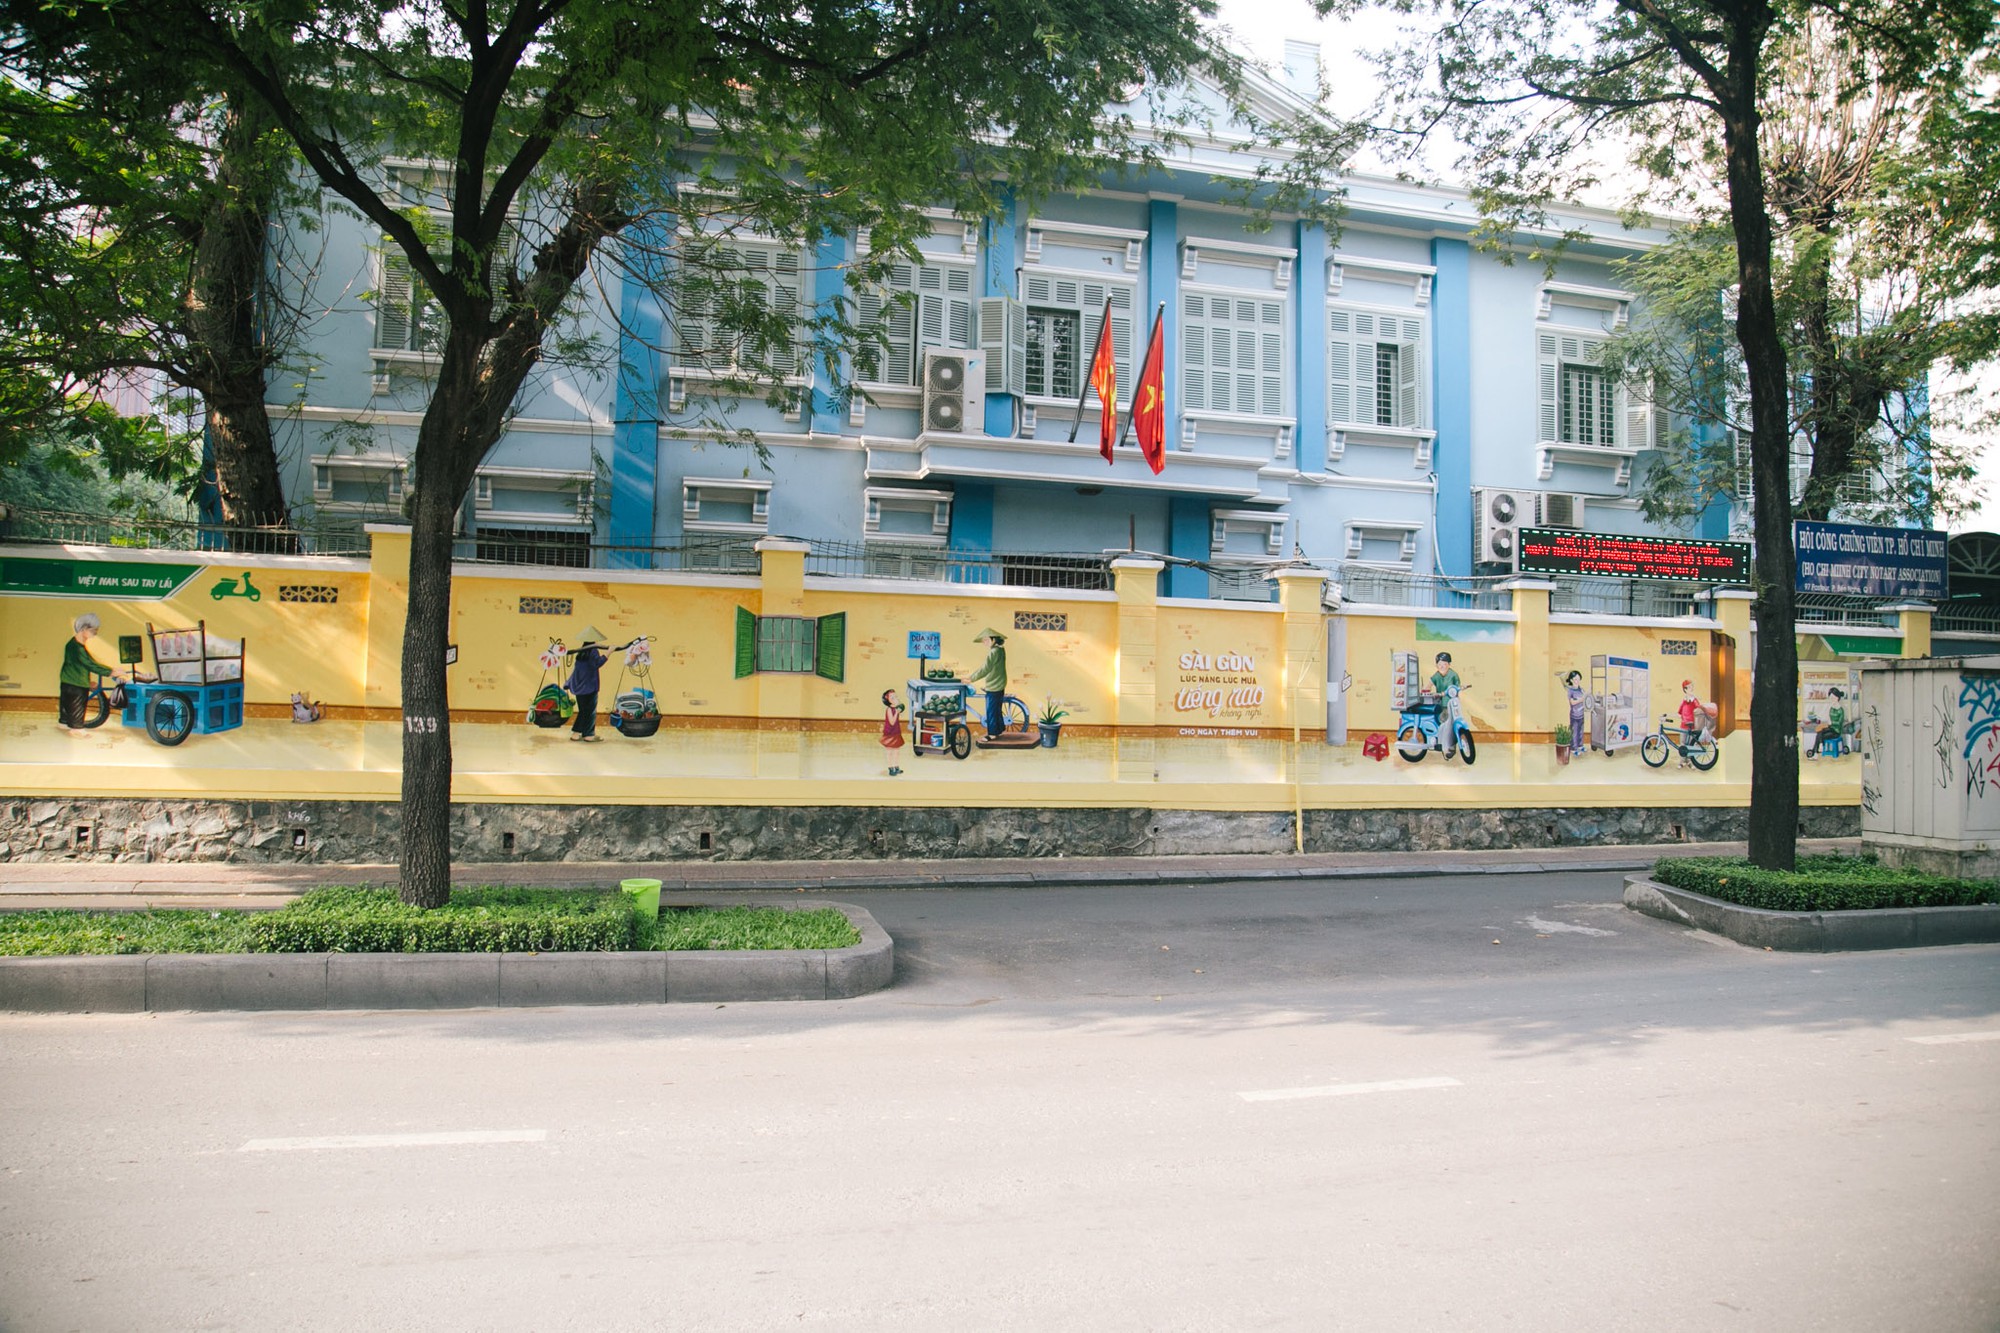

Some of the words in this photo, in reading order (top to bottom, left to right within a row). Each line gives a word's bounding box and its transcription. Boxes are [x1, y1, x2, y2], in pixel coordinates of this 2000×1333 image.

[1799, 526, 1814, 553] HỘI
[1815, 527, 1837, 551] CÔNG
[1838, 529, 1865, 553] CHỨNG
[1865, 531, 1884, 553] VIÊN
[1885, 536, 1896, 555] TP.
[1897, 531, 1909, 556] HỒ
[1910, 535, 1925, 557] CHÍ
[1926, 540, 1945, 558] MINH
[78, 573, 97, 587] VIỆT
[98, 576, 119, 587] NAM
[121, 578, 139, 587] SAU
[141, 578, 157, 588] TAY
[158, 576, 173, 589] LÁI
[1802, 561, 1815, 578] (HO
[1816, 562, 1829, 577] CHI
[1830, 563, 1852, 578] MINH
[1853, 565, 1869, 579] CITY
[1869, 566, 1897, 580] NOTARY
[1898, 567, 1941, 585] ASSOCIATION)
[1179, 648, 1211, 671] SÀI
[1215, 650, 1255, 672] GÒN
[1180, 672, 1197, 683] LÚC
[1222, 674, 1239, 684] LÚC
[405, 716, 437, 734] 139
[1179, 728, 1196, 736] CHO
[1244, 729, 1259, 737] VUI
